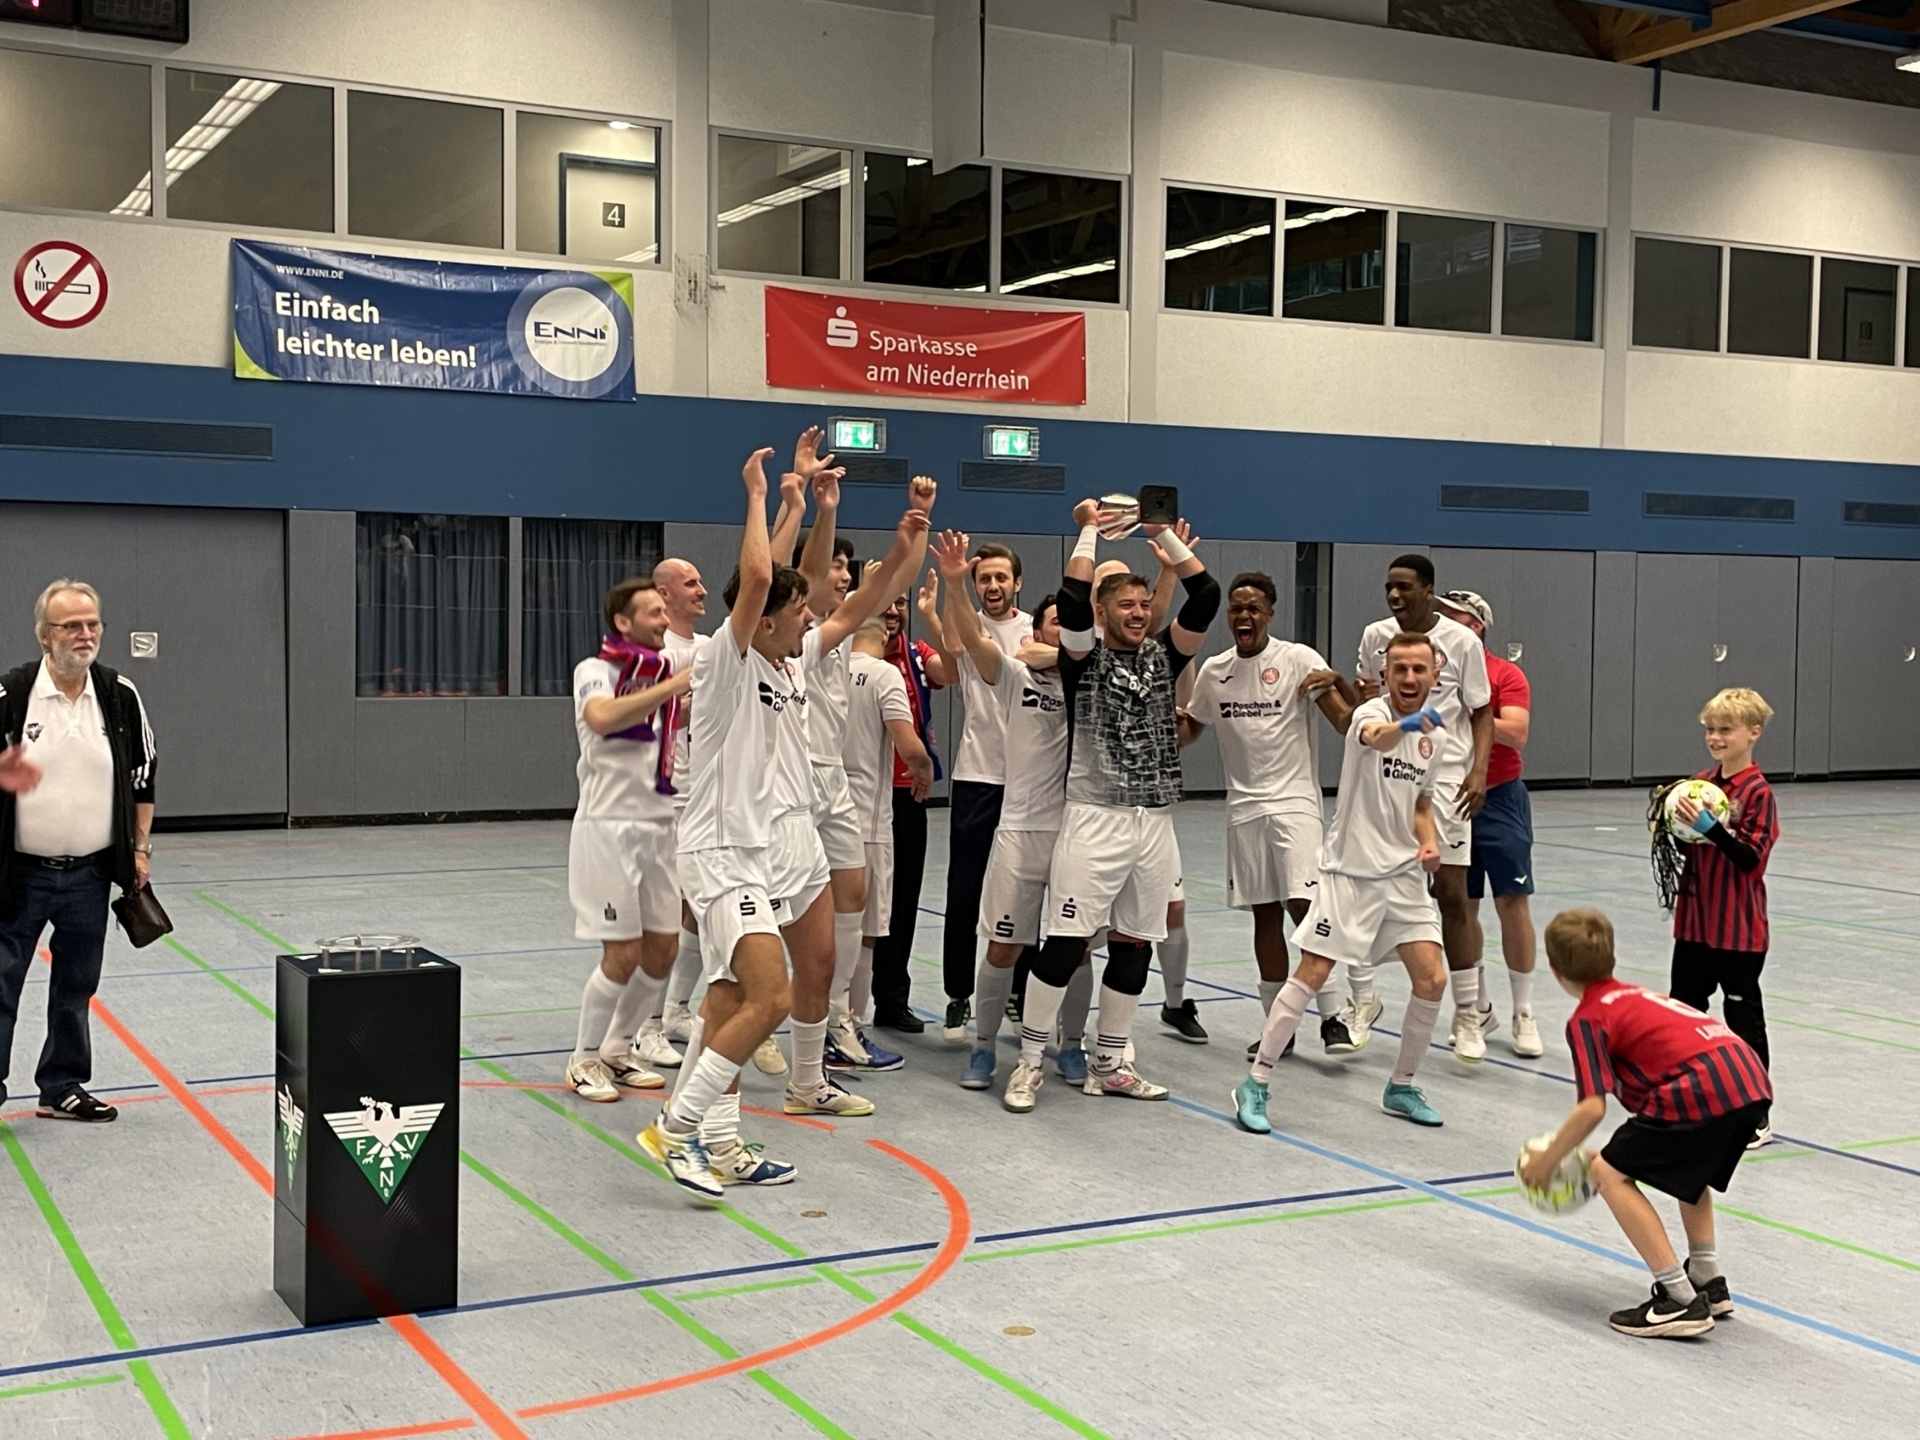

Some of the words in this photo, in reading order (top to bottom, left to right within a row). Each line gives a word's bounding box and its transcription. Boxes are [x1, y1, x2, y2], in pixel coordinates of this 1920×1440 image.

[607, 205, 621, 226] 4
[276, 265, 344, 280] WWW.ENNI.DE
[275, 291, 380, 324] Einfach
[277, 328, 384, 361] leichter
[391, 338, 477, 368] leben!
[869, 330, 978, 357] Sparkasse
[866, 364, 899, 383] am
[906, 363, 1030, 390] Niederrhein
